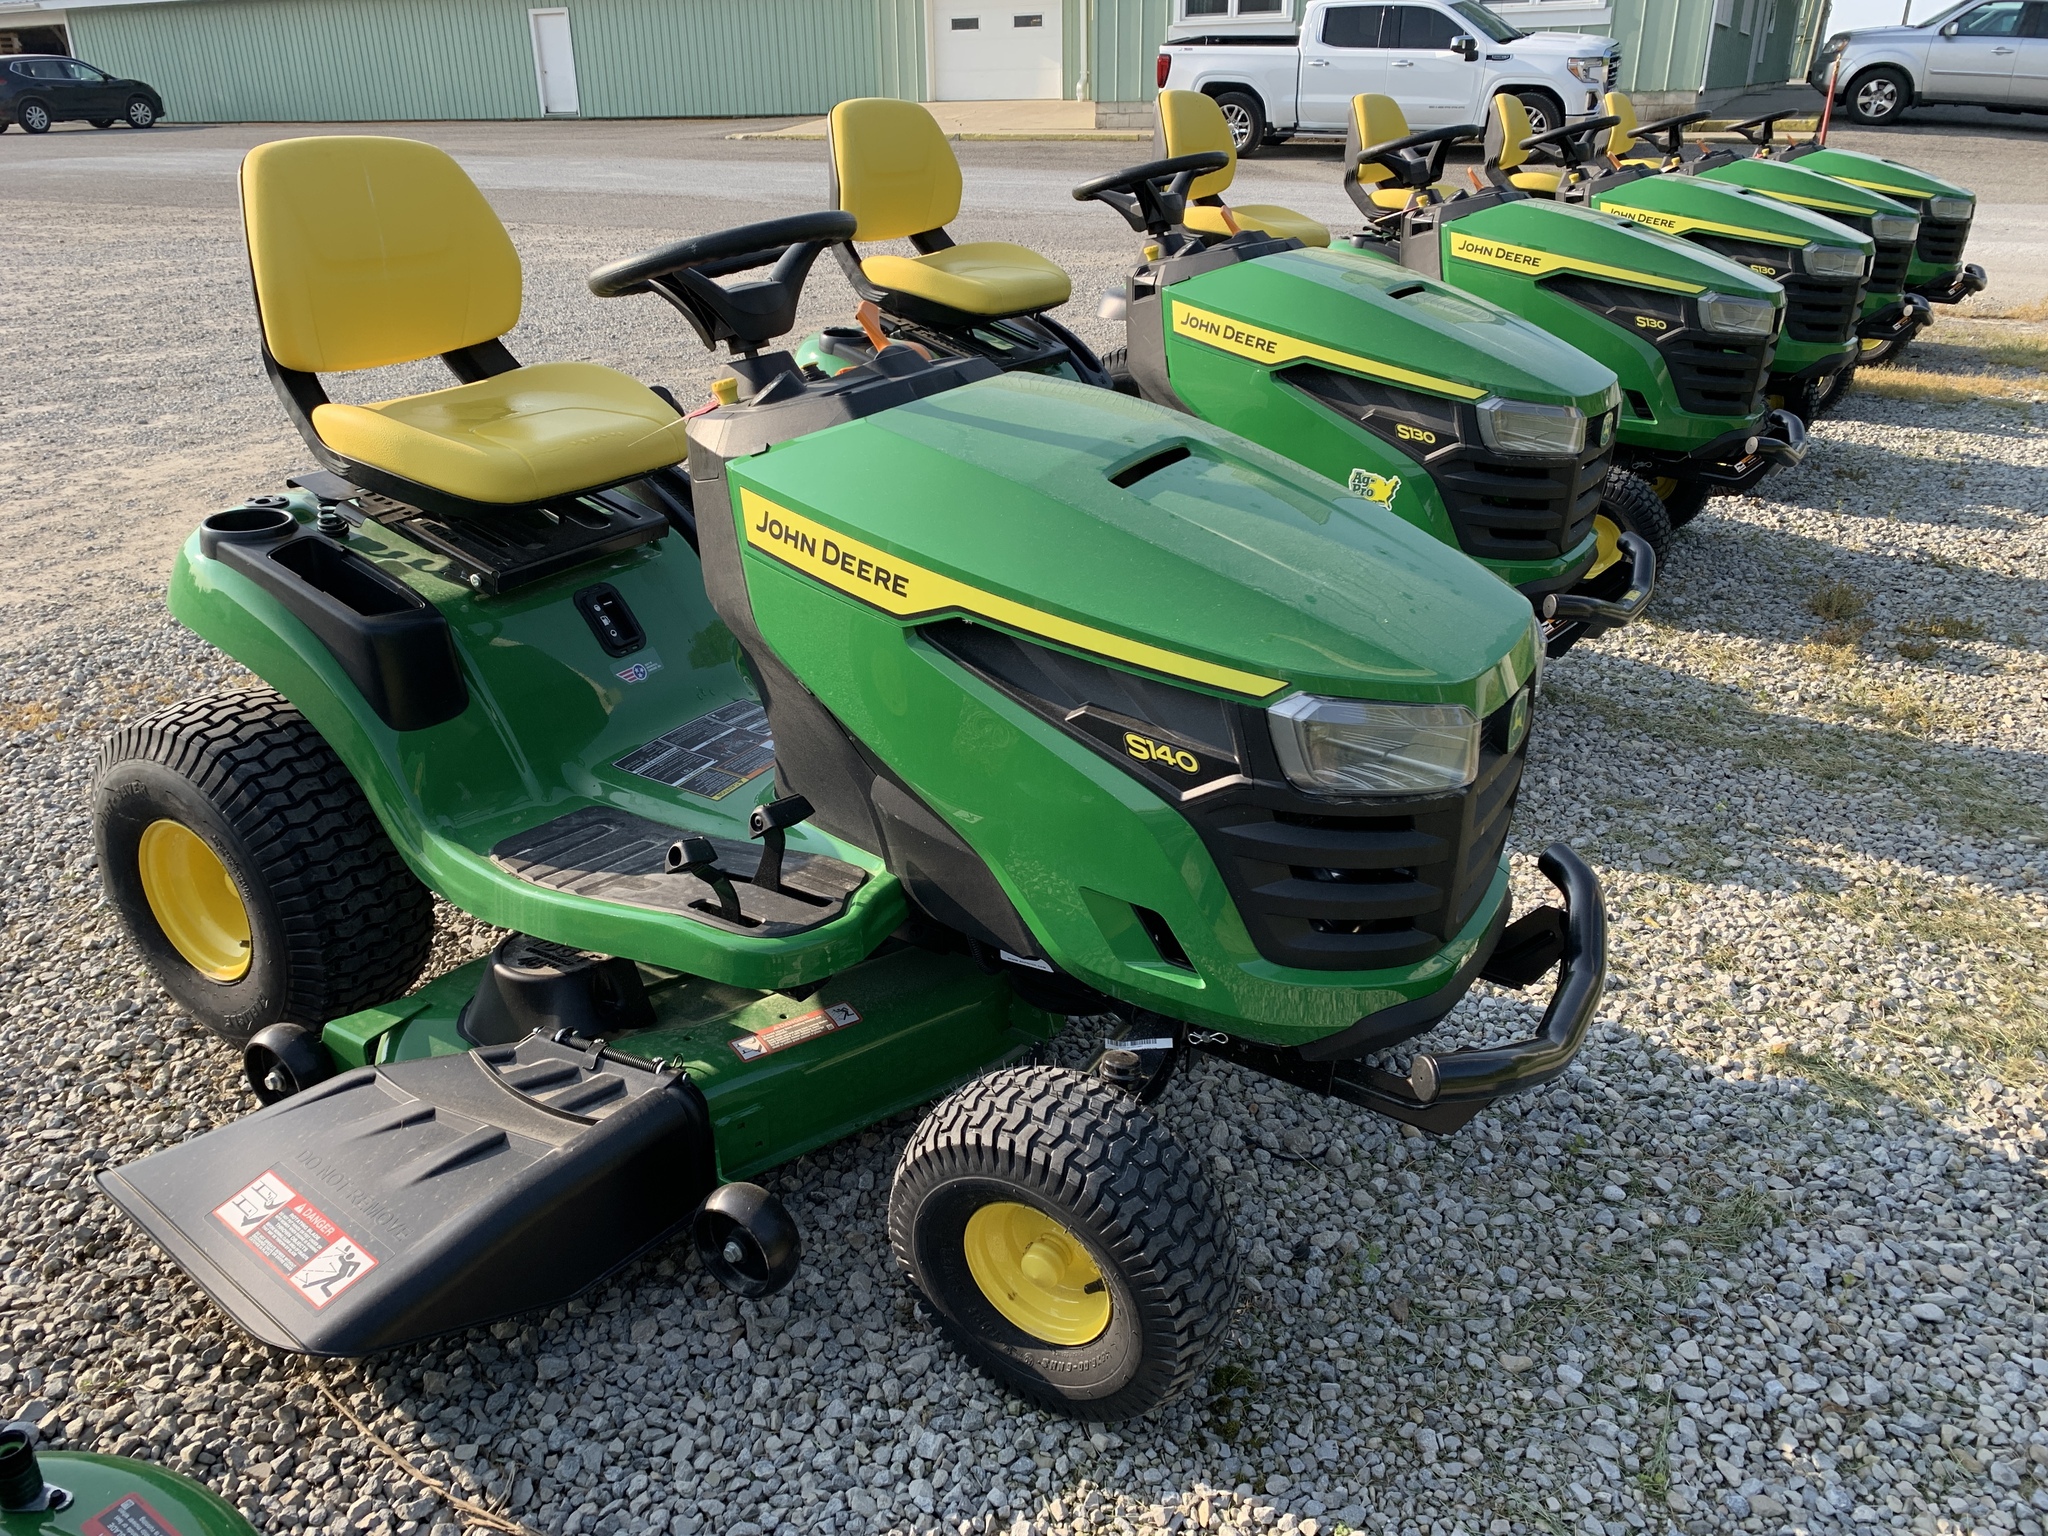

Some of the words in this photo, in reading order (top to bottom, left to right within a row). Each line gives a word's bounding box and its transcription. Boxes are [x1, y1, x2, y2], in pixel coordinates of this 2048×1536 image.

[1637, 213, 1677, 229] DEERE
[1457, 240, 1493, 257] JOHN
[1494, 247, 1542, 267] DEERE
[1750, 264, 1776, 276] S130
[1180, 312, 1221, 336] JOHN
[1222, 324, 1278, 354] DEERE
[1635, 315, 1667, 330] S130
[1396, 423, 1436, 444] S130
[1352, 483, 1374, 497] Pro
[756, 510, 817, 558] JOHN
[821, 538, 910, 599] DEERE
[1124, 732, 1199, 774] S140
[294, 1149, 322, 1170] DO
[316, 1164, 354, 1193] NOT
[345, 1188, 414, 1242] REMOVE
[302, 1207, 336, 1237] DANGER
